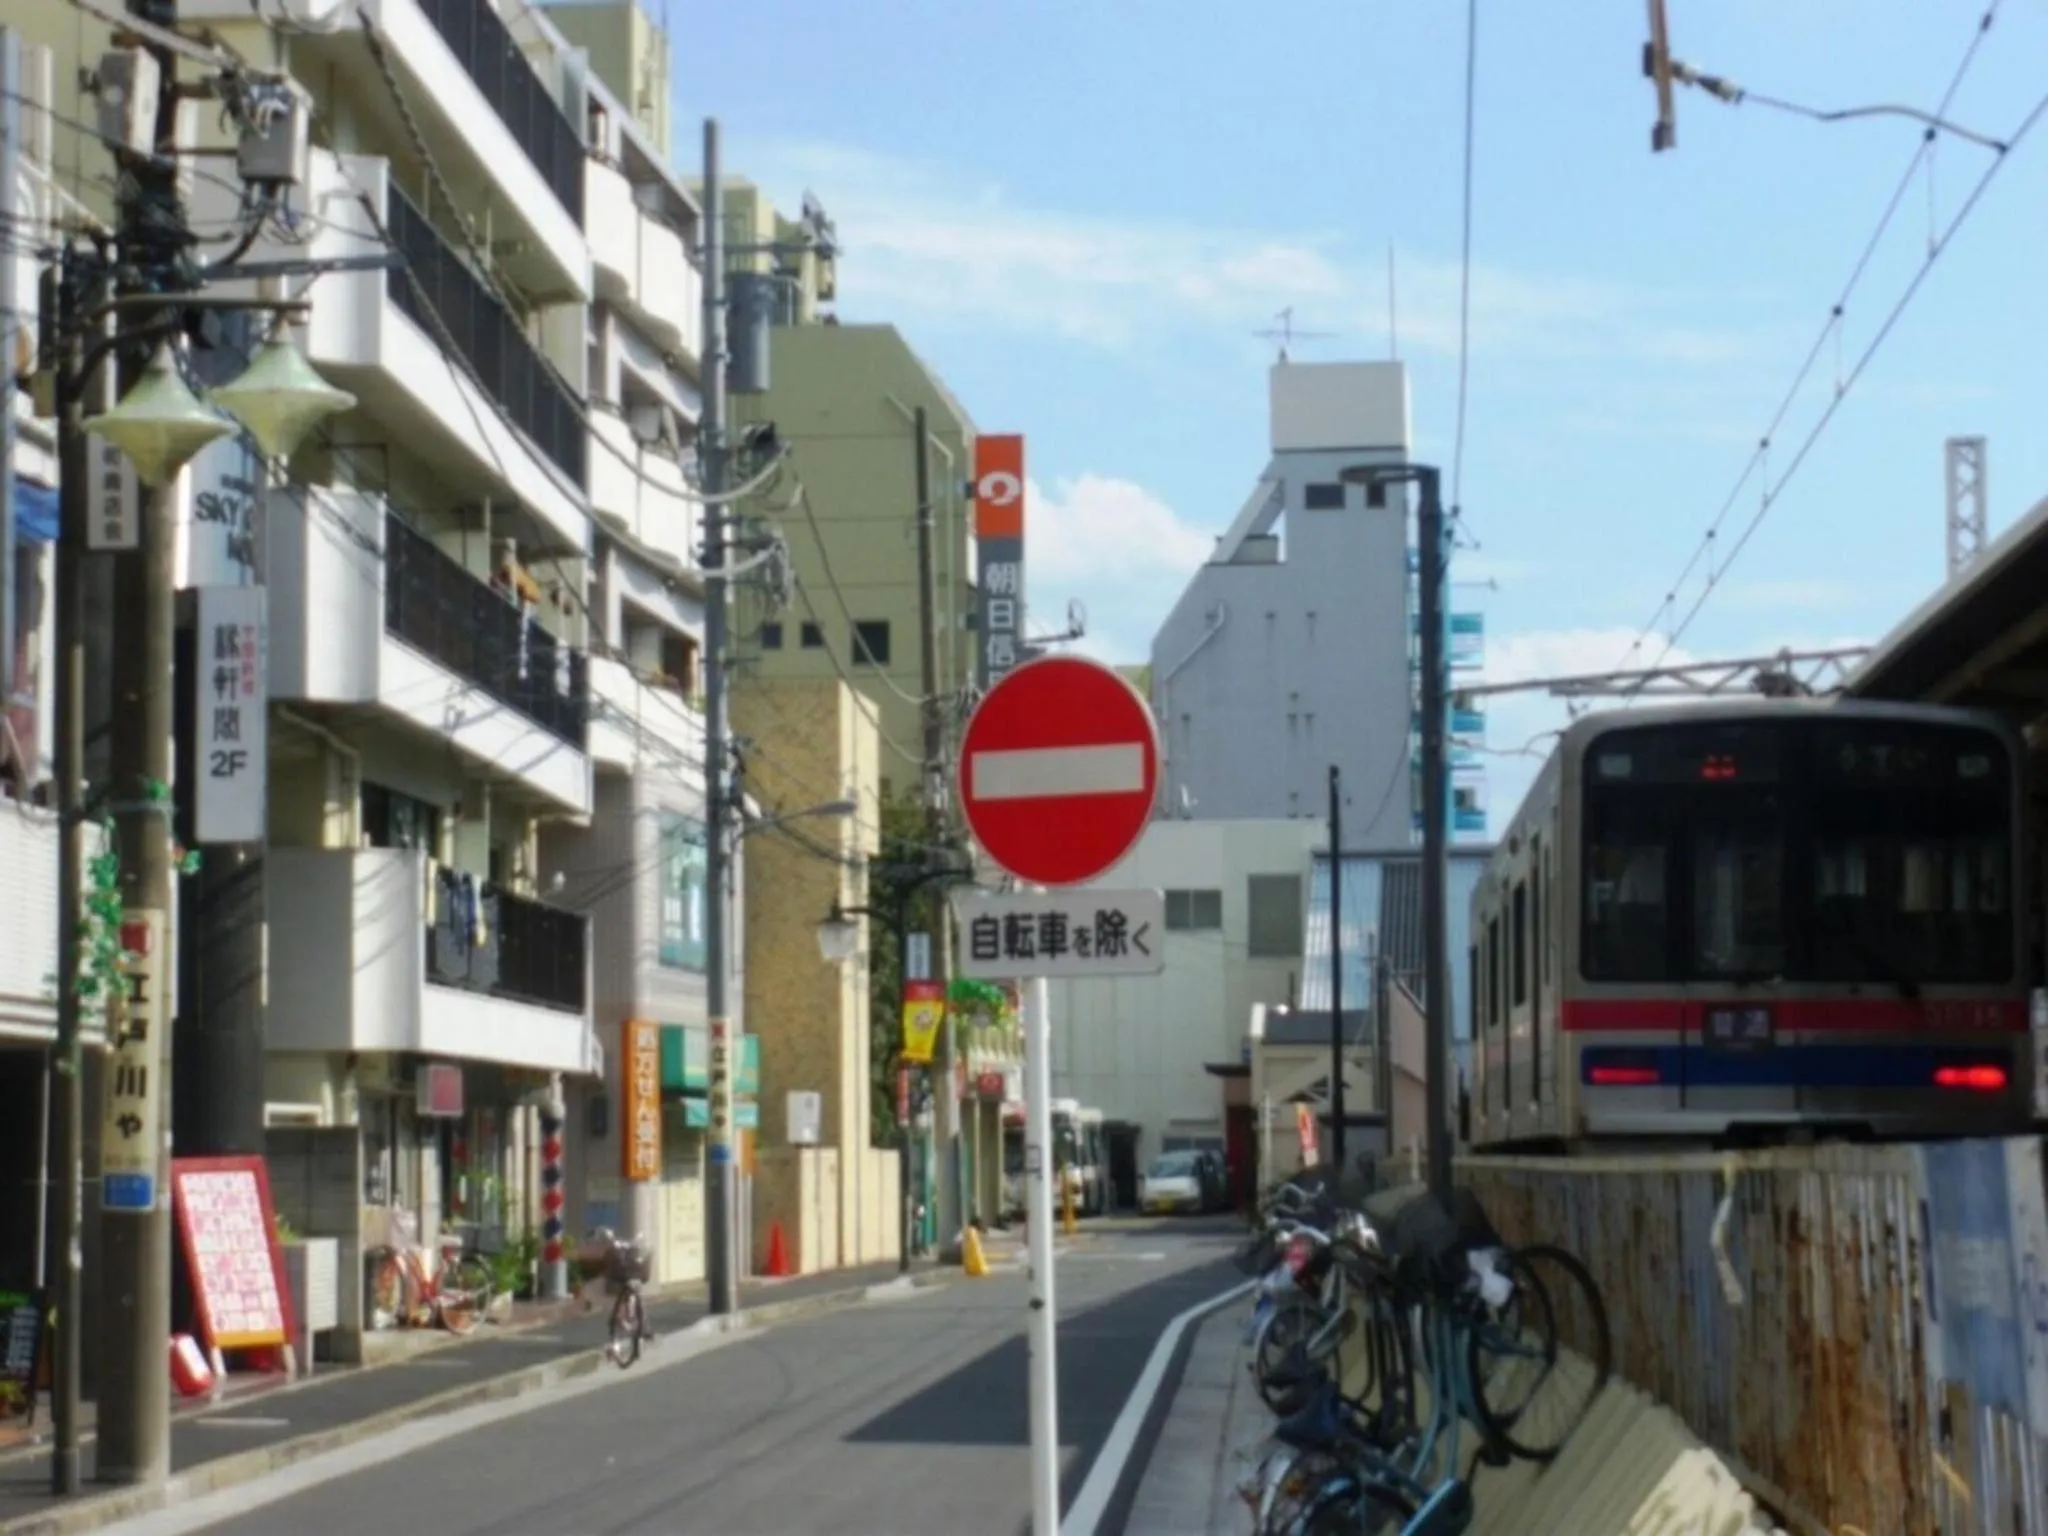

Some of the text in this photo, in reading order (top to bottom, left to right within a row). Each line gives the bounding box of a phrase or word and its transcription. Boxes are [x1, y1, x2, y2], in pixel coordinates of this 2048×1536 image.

[195, 491, 240, 525] SKY
[209, 750, 248, 778] 2F
[971, 908, 1151, 960] 自転車を除く
